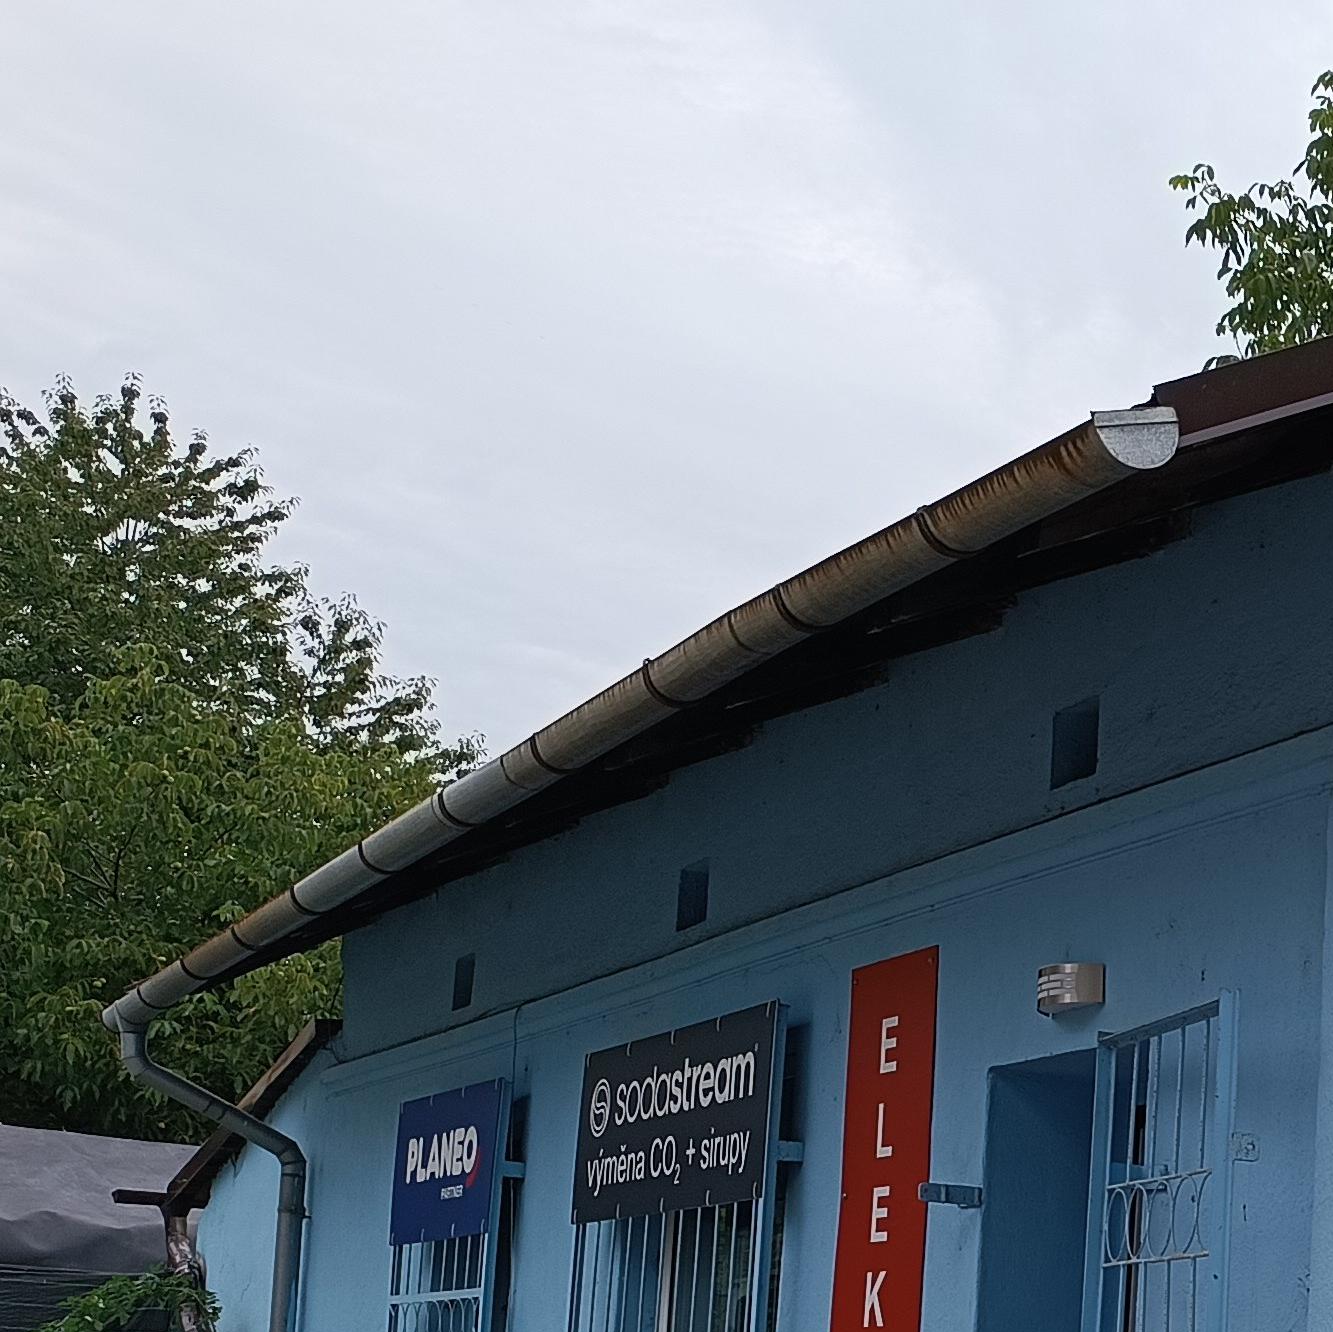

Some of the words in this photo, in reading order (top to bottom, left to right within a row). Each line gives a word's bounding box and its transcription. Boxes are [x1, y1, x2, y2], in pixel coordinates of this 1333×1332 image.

[615, 1051, 755, 1126] sodastream
[406, 1126, 478, 1185] PLANEO
[587, 1144, 646, 1197] výměna
[686, 1138, 696, 1165] +
[700, 1127, 751, 1175] sirupy
